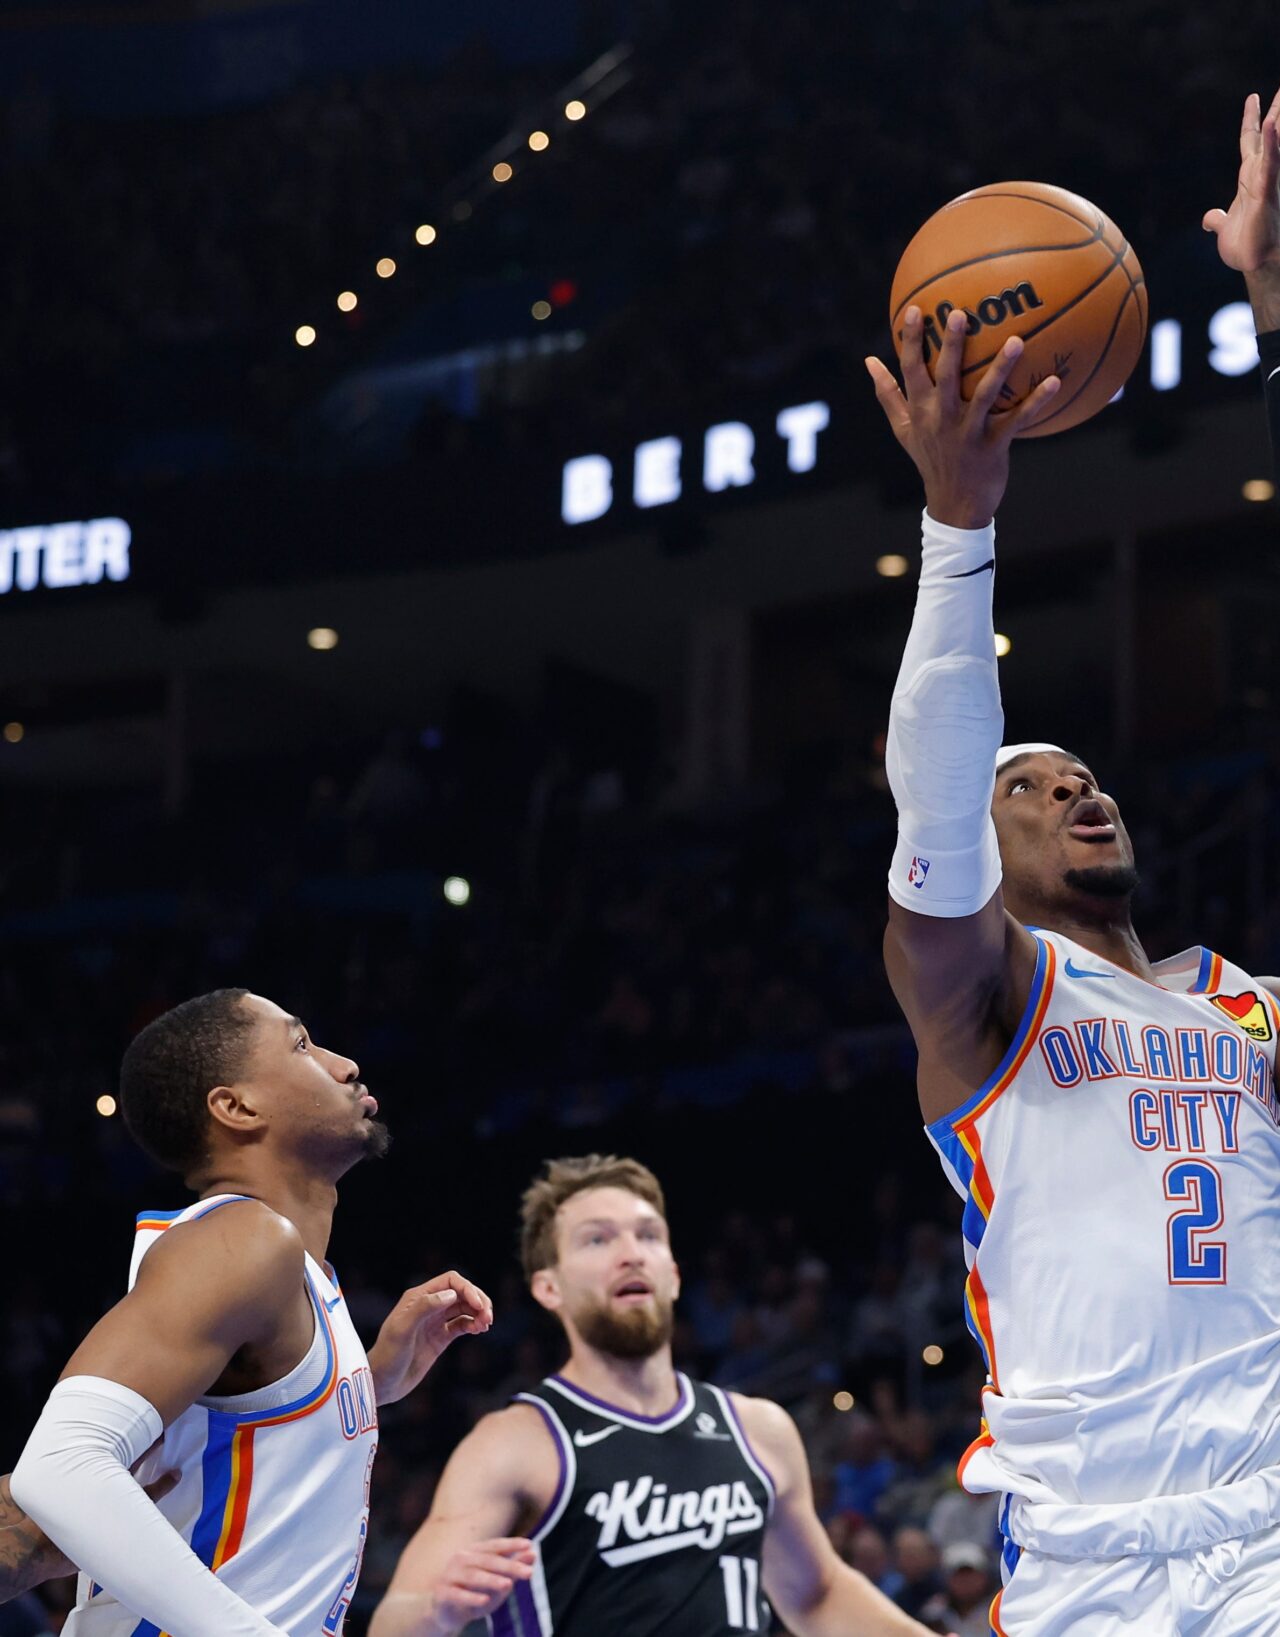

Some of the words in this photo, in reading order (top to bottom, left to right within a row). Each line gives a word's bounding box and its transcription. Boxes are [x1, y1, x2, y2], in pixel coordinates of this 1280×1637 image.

[898, 281, 1043, 364] ilson
[561, 400, 830, 525] BERT
[1129, 1088, 1242, 1153] CITY
[1163, 1158, 1228, 1285] 2
[584, 1475, 764, 1568] Kings
[719, 1555, 759, 1631] 11
